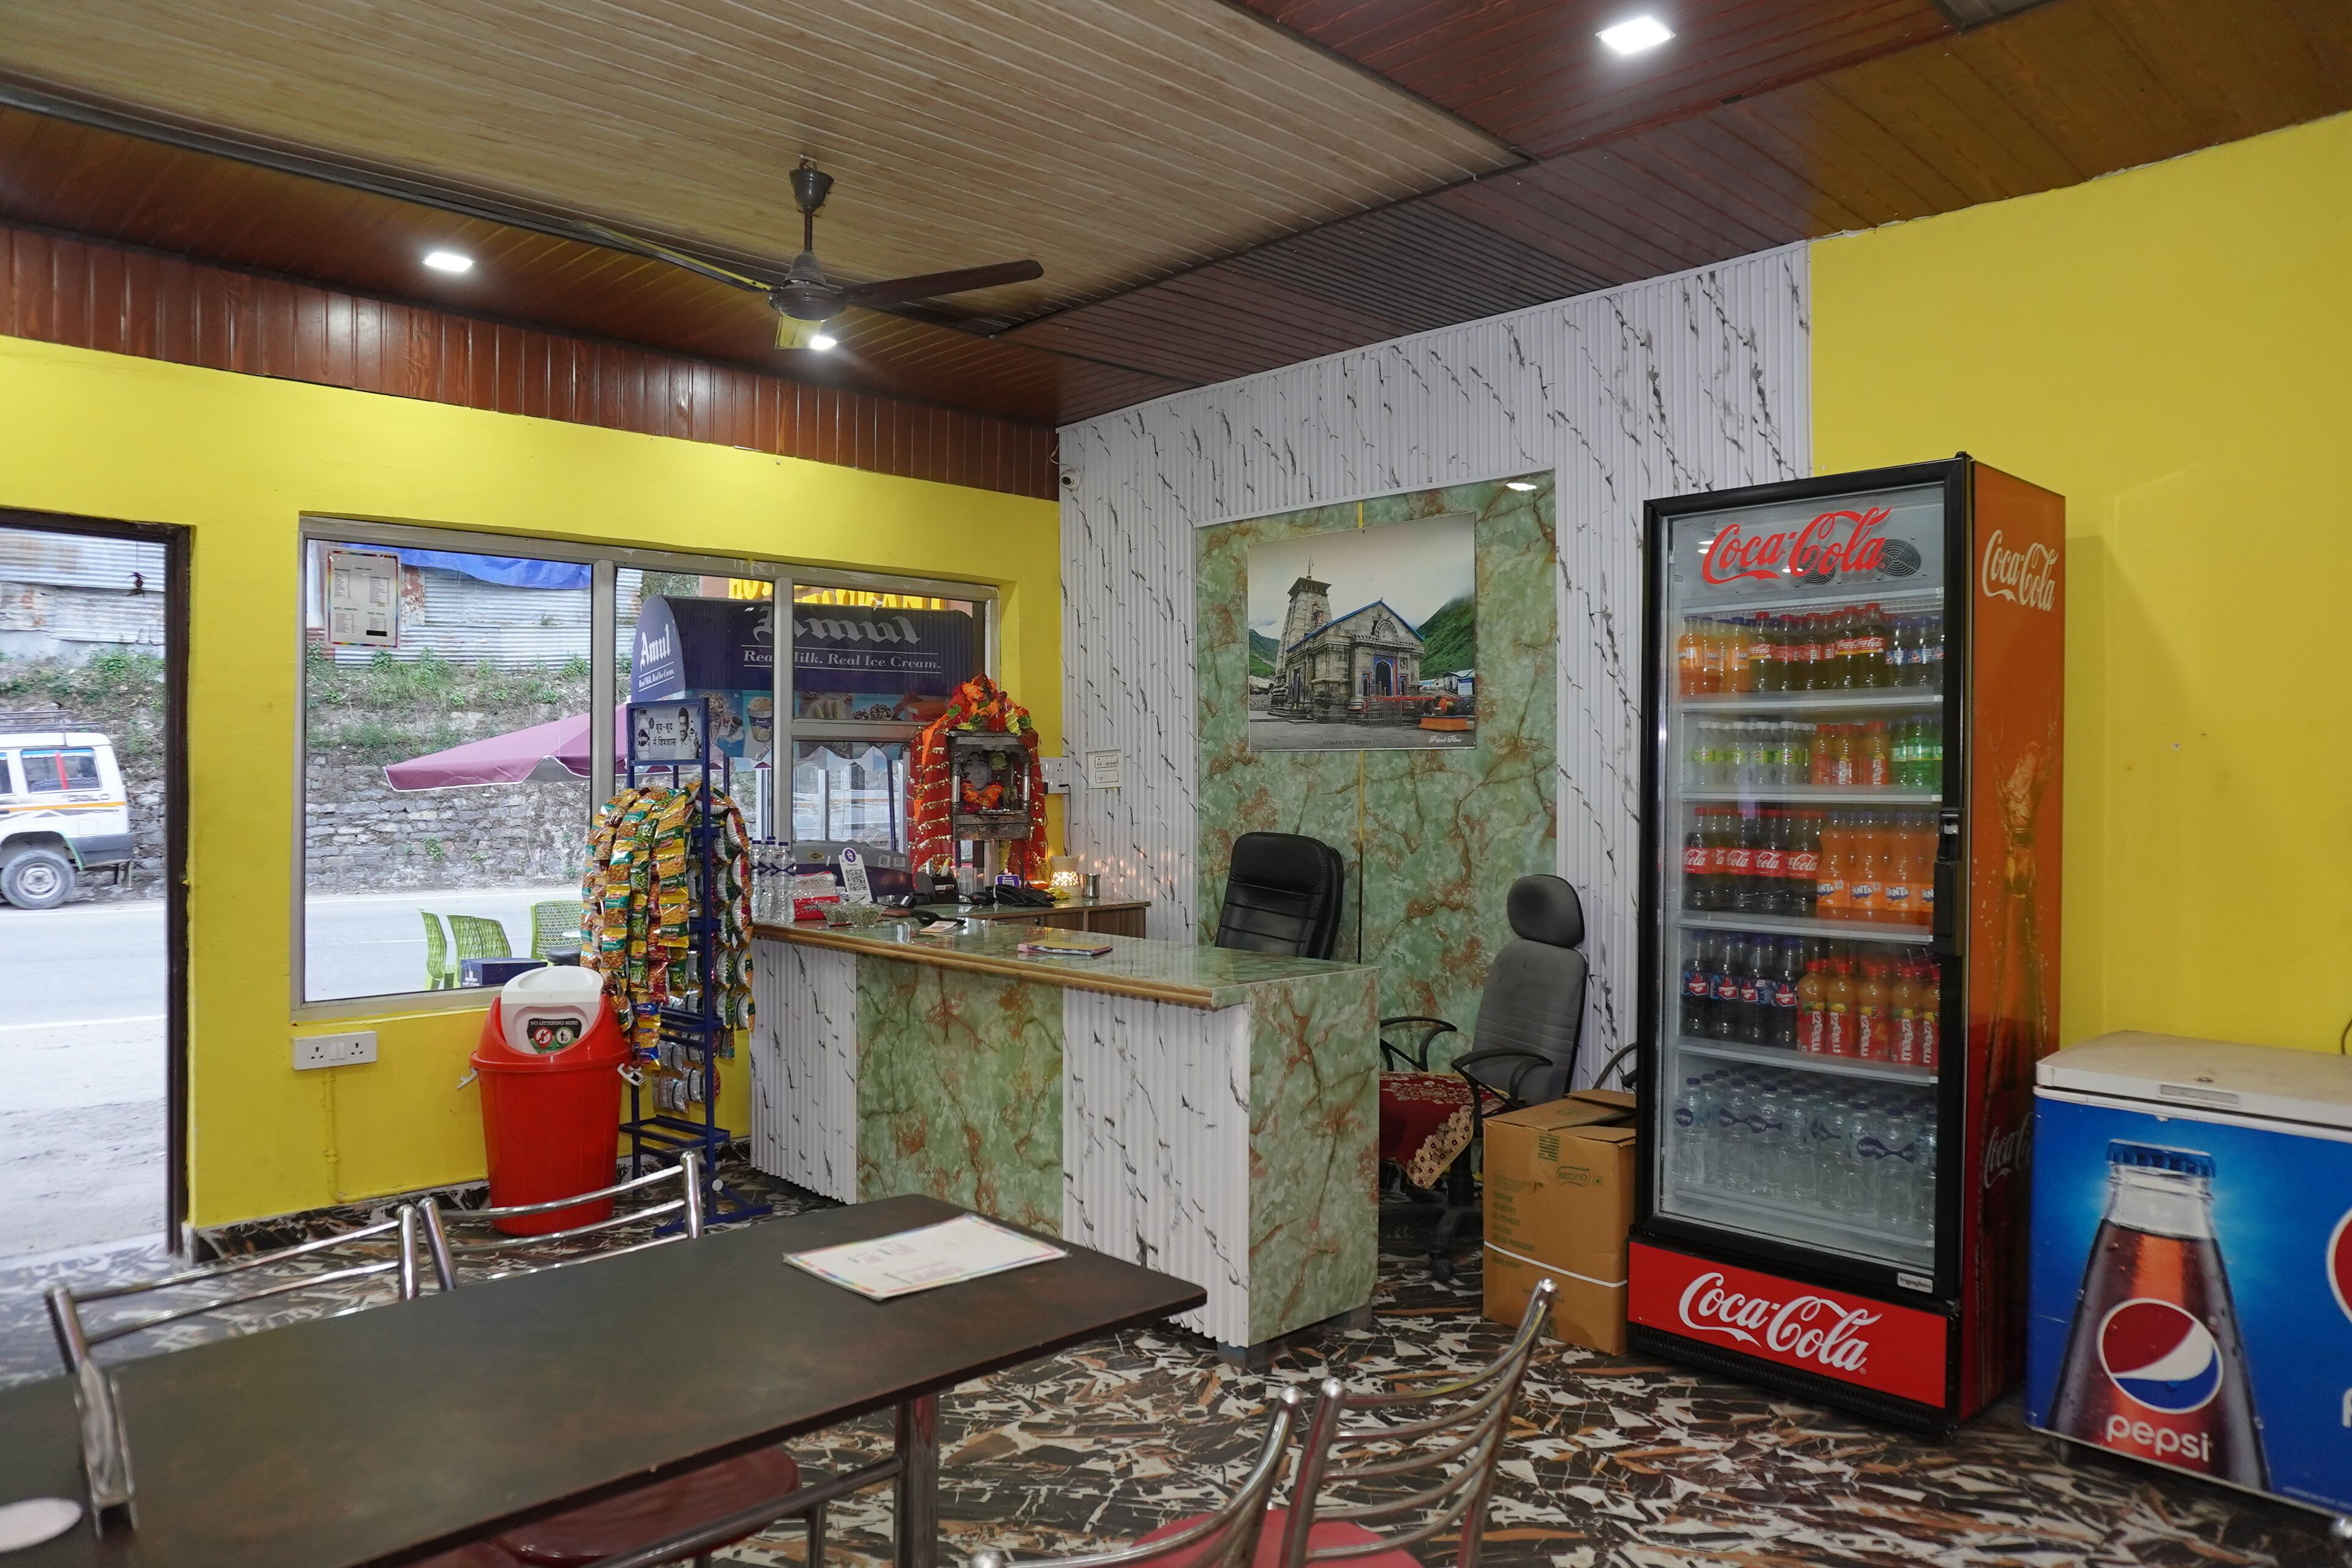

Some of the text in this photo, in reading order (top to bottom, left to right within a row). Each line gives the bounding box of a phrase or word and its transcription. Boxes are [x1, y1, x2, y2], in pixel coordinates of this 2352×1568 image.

[1702, 506, 1892, 584] Coca-Cola
[1982, 529, 2059, 612] Coca-Cola
[640, 623, 671, 672] Amul
[744, 650, 772, 663] Rea
[827, 654, 860, 666] Real
[865, 657, 886, 667] Ice
[890, 656, 941, 669] Cream.
[1679, 1272, 1882, 1372] Coca-Cola
[2106, 1414, 2209, 1463] pepsi
